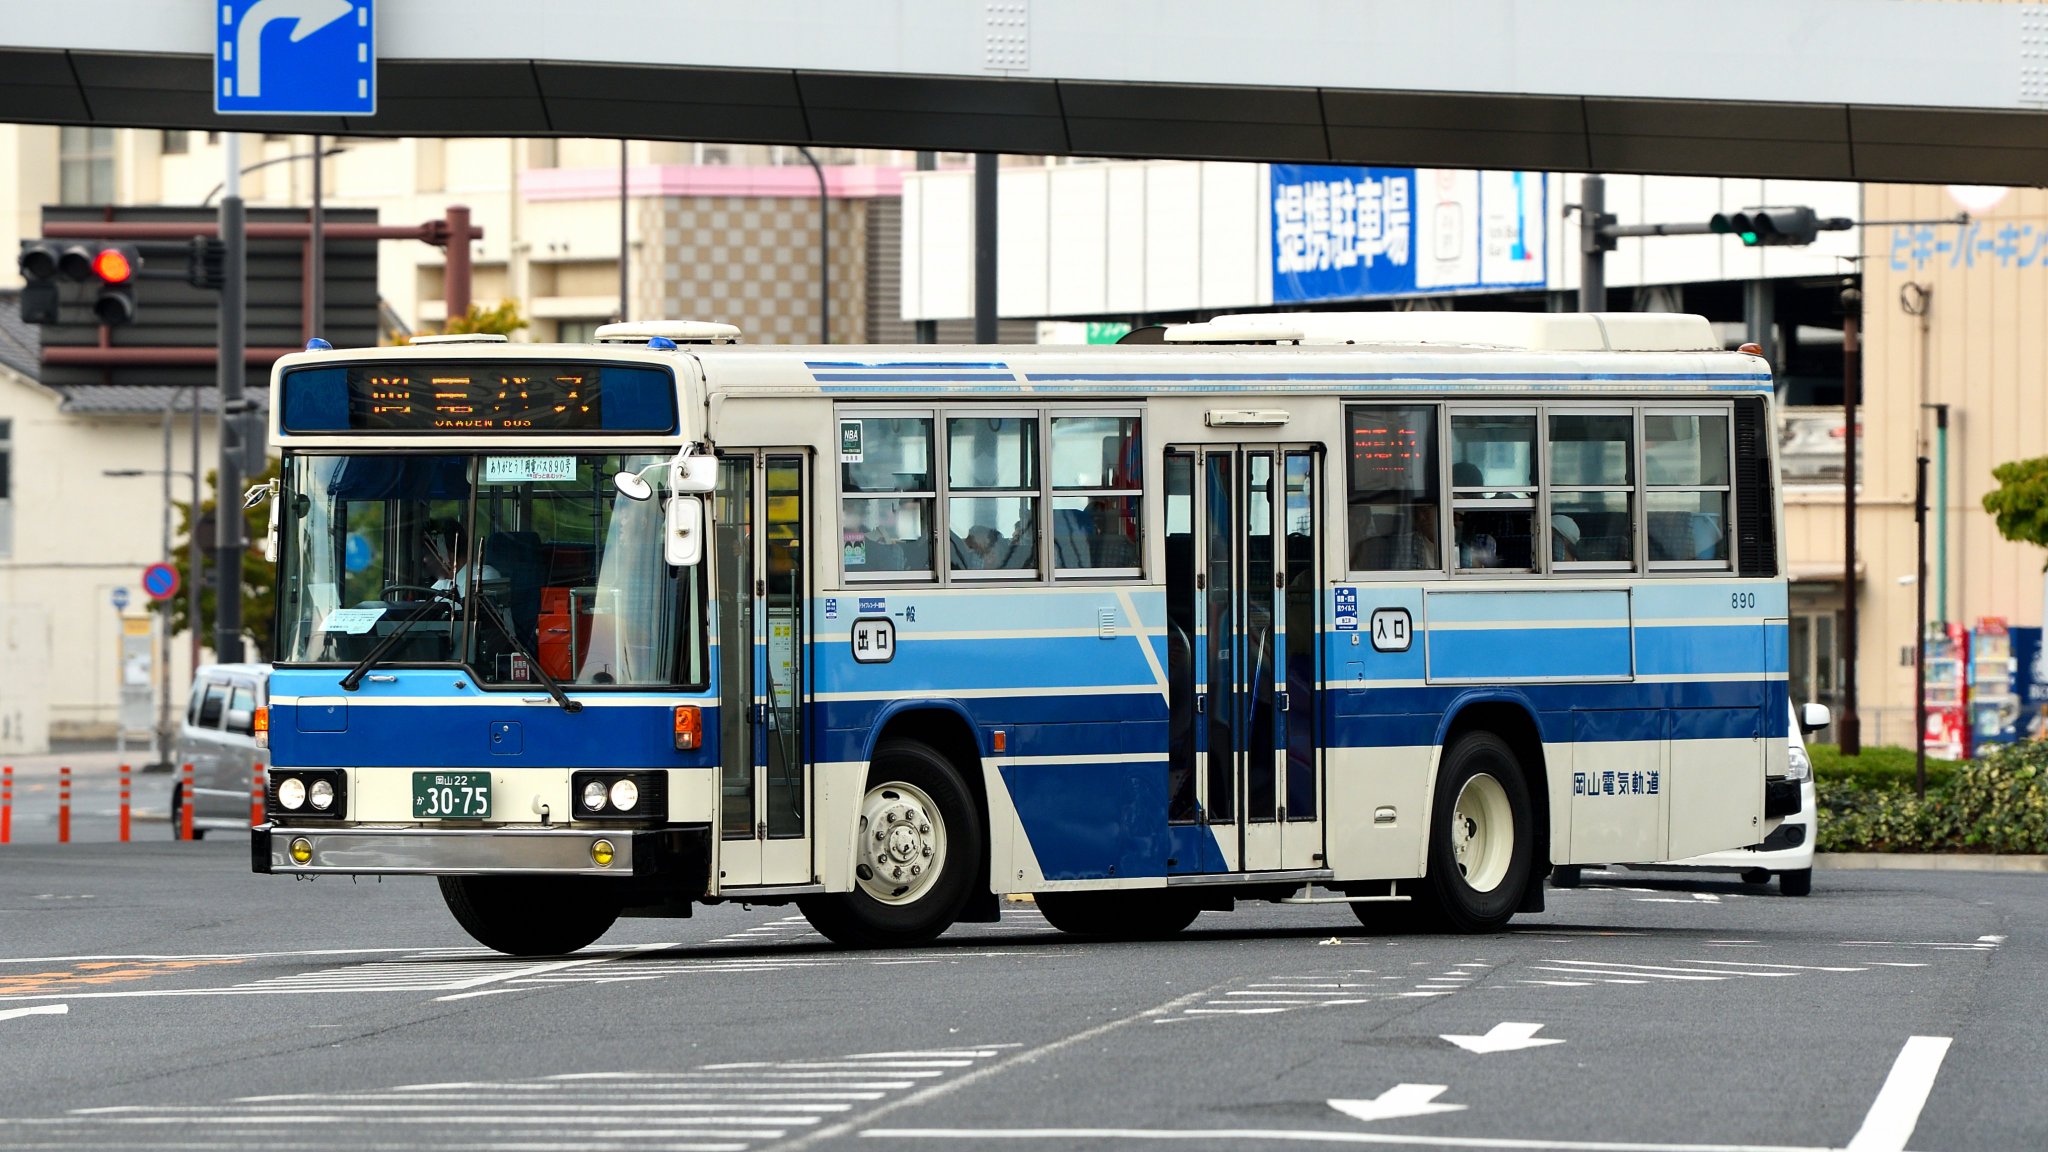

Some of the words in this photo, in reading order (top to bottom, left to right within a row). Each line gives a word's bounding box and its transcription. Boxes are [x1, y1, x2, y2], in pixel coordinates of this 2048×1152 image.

[1275, 176, 1410, 274] 提携駐車場
[844, 429, 859, 442] NBA
[1731, 592, 1755, 609] 890
[895, 605, 916, 623] 一般
[1377, 618, 1404, 639] 入口
[858, 629, 887, 651] 出口
[436, 775, 468, 786] 岡山22
[1573, 769, 1659, 796] 岡山電気軌道
[416, 796, 425, 805] か
[427, 787, 488, 815] 30-75
